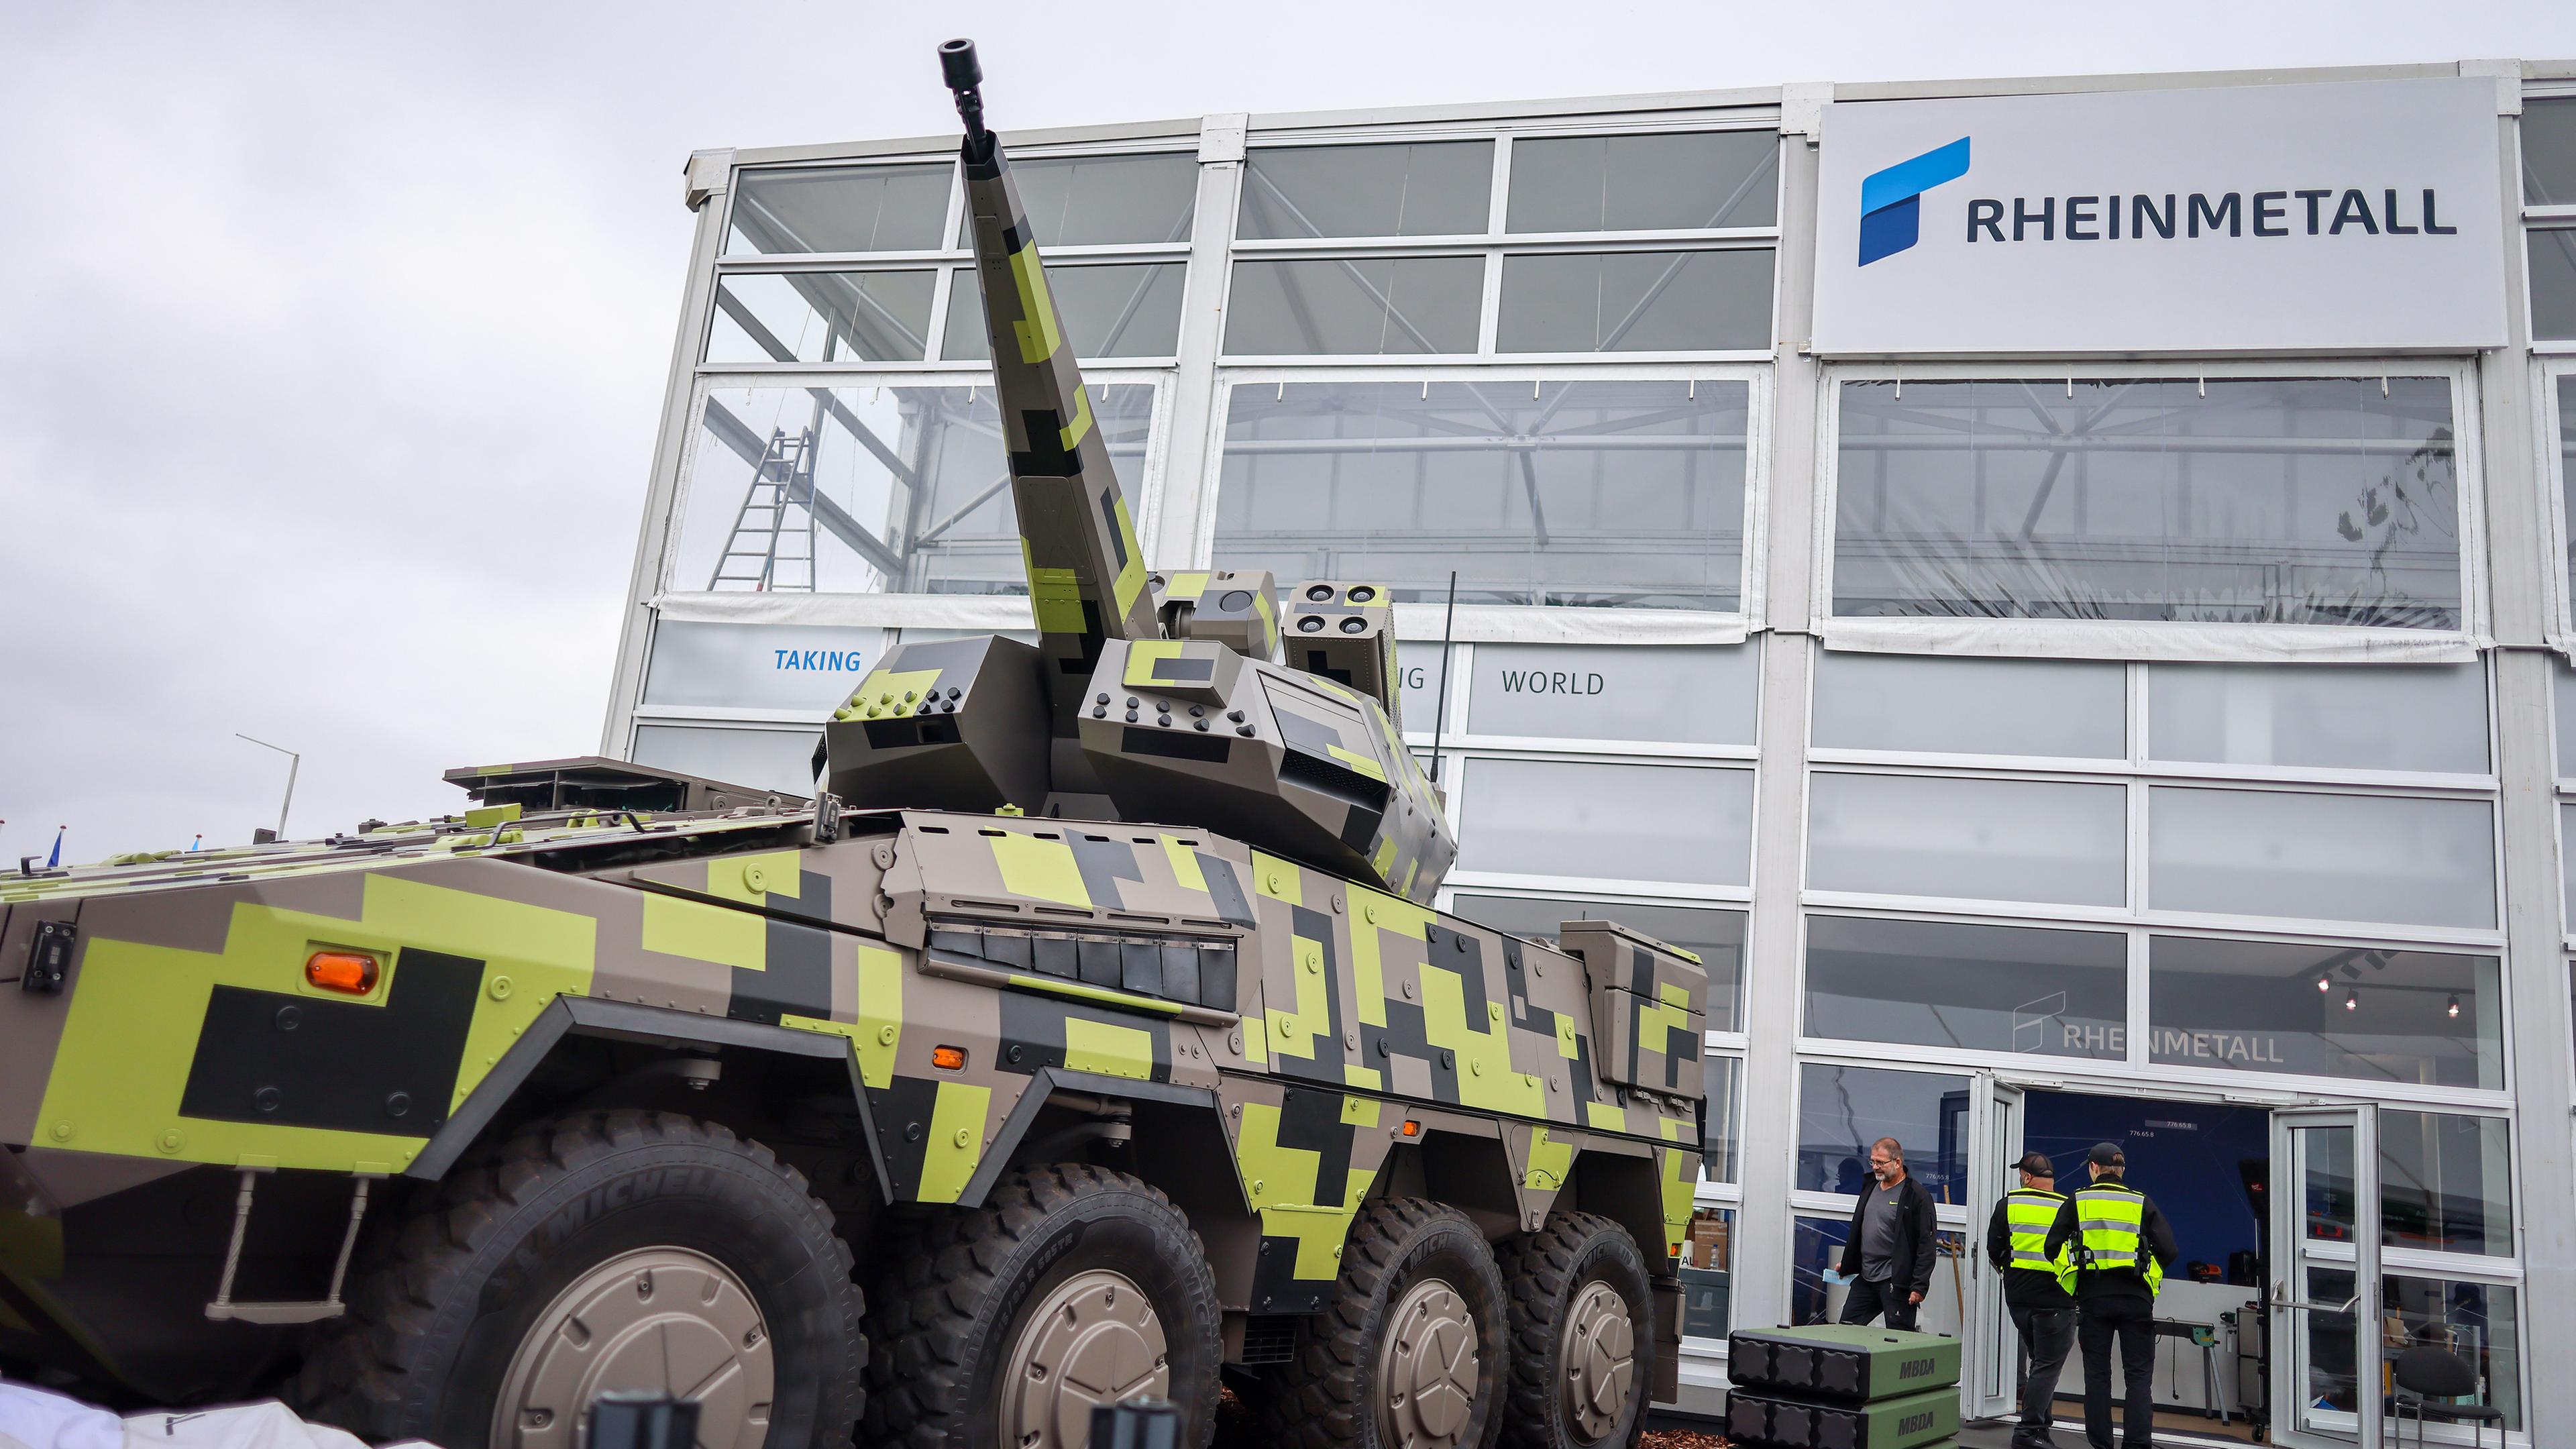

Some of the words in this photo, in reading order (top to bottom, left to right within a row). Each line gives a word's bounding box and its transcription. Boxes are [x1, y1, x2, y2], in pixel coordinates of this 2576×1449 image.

[1966, 188, 2458, 242] RHEINMETALL
[775, 649, 861, 672] TAKING
[1399, 667, 1424, 689] G
[1502, 670, 1605, 696] WORLD
[2063, 1024, 2284, 1063] RHENMETALL
[1899, 1358, 1935, 1380] MBDA
[1897, 1411, 1933, 1437] MBDA
